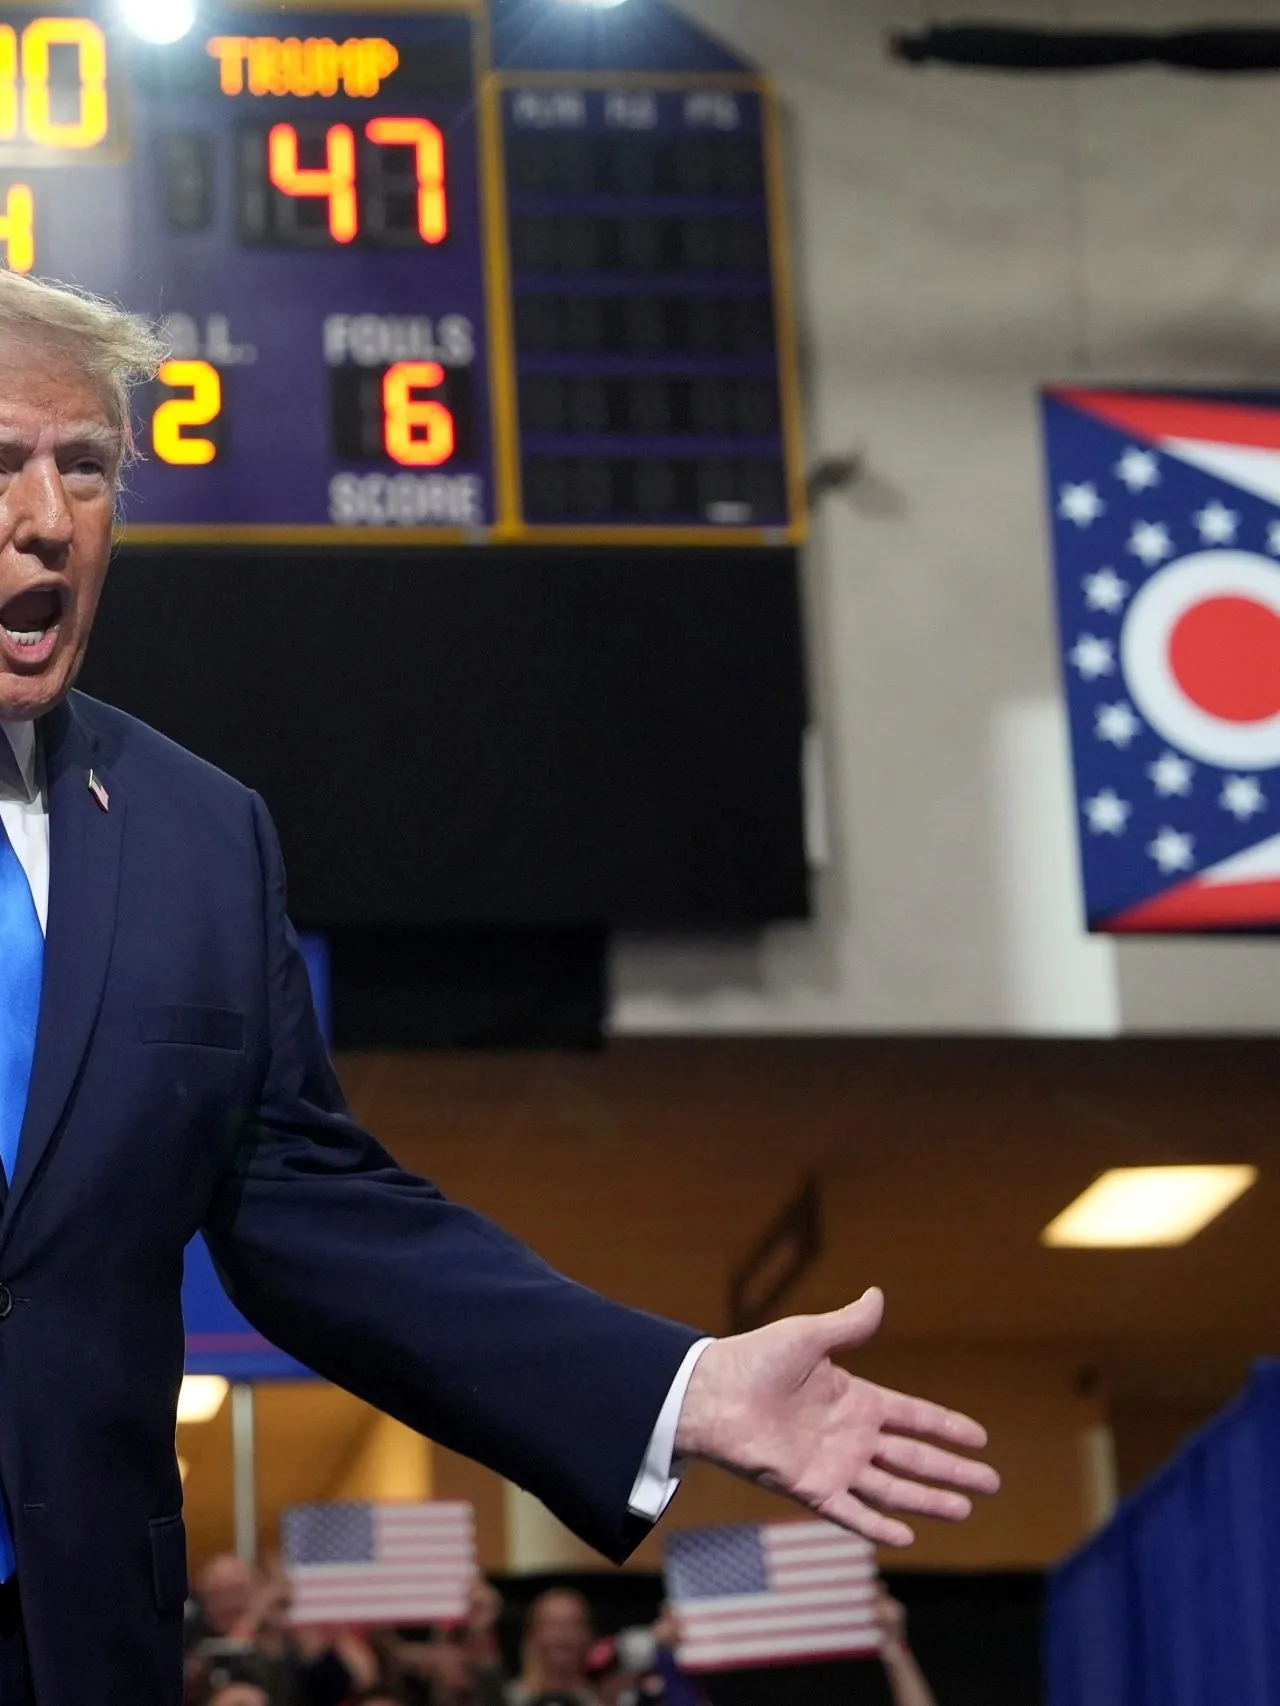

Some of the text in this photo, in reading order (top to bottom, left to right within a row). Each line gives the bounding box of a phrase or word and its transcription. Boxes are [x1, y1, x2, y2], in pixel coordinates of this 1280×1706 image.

[208, 36, 399, 97] TRUMP
[268, 117, 447, 244] 47
[324, 314, 475, 366] FOULS
[152, 360, 221, 465] 2
[382, 361, 454, 466] 6
[328, 474, 483, 526] SCORE
